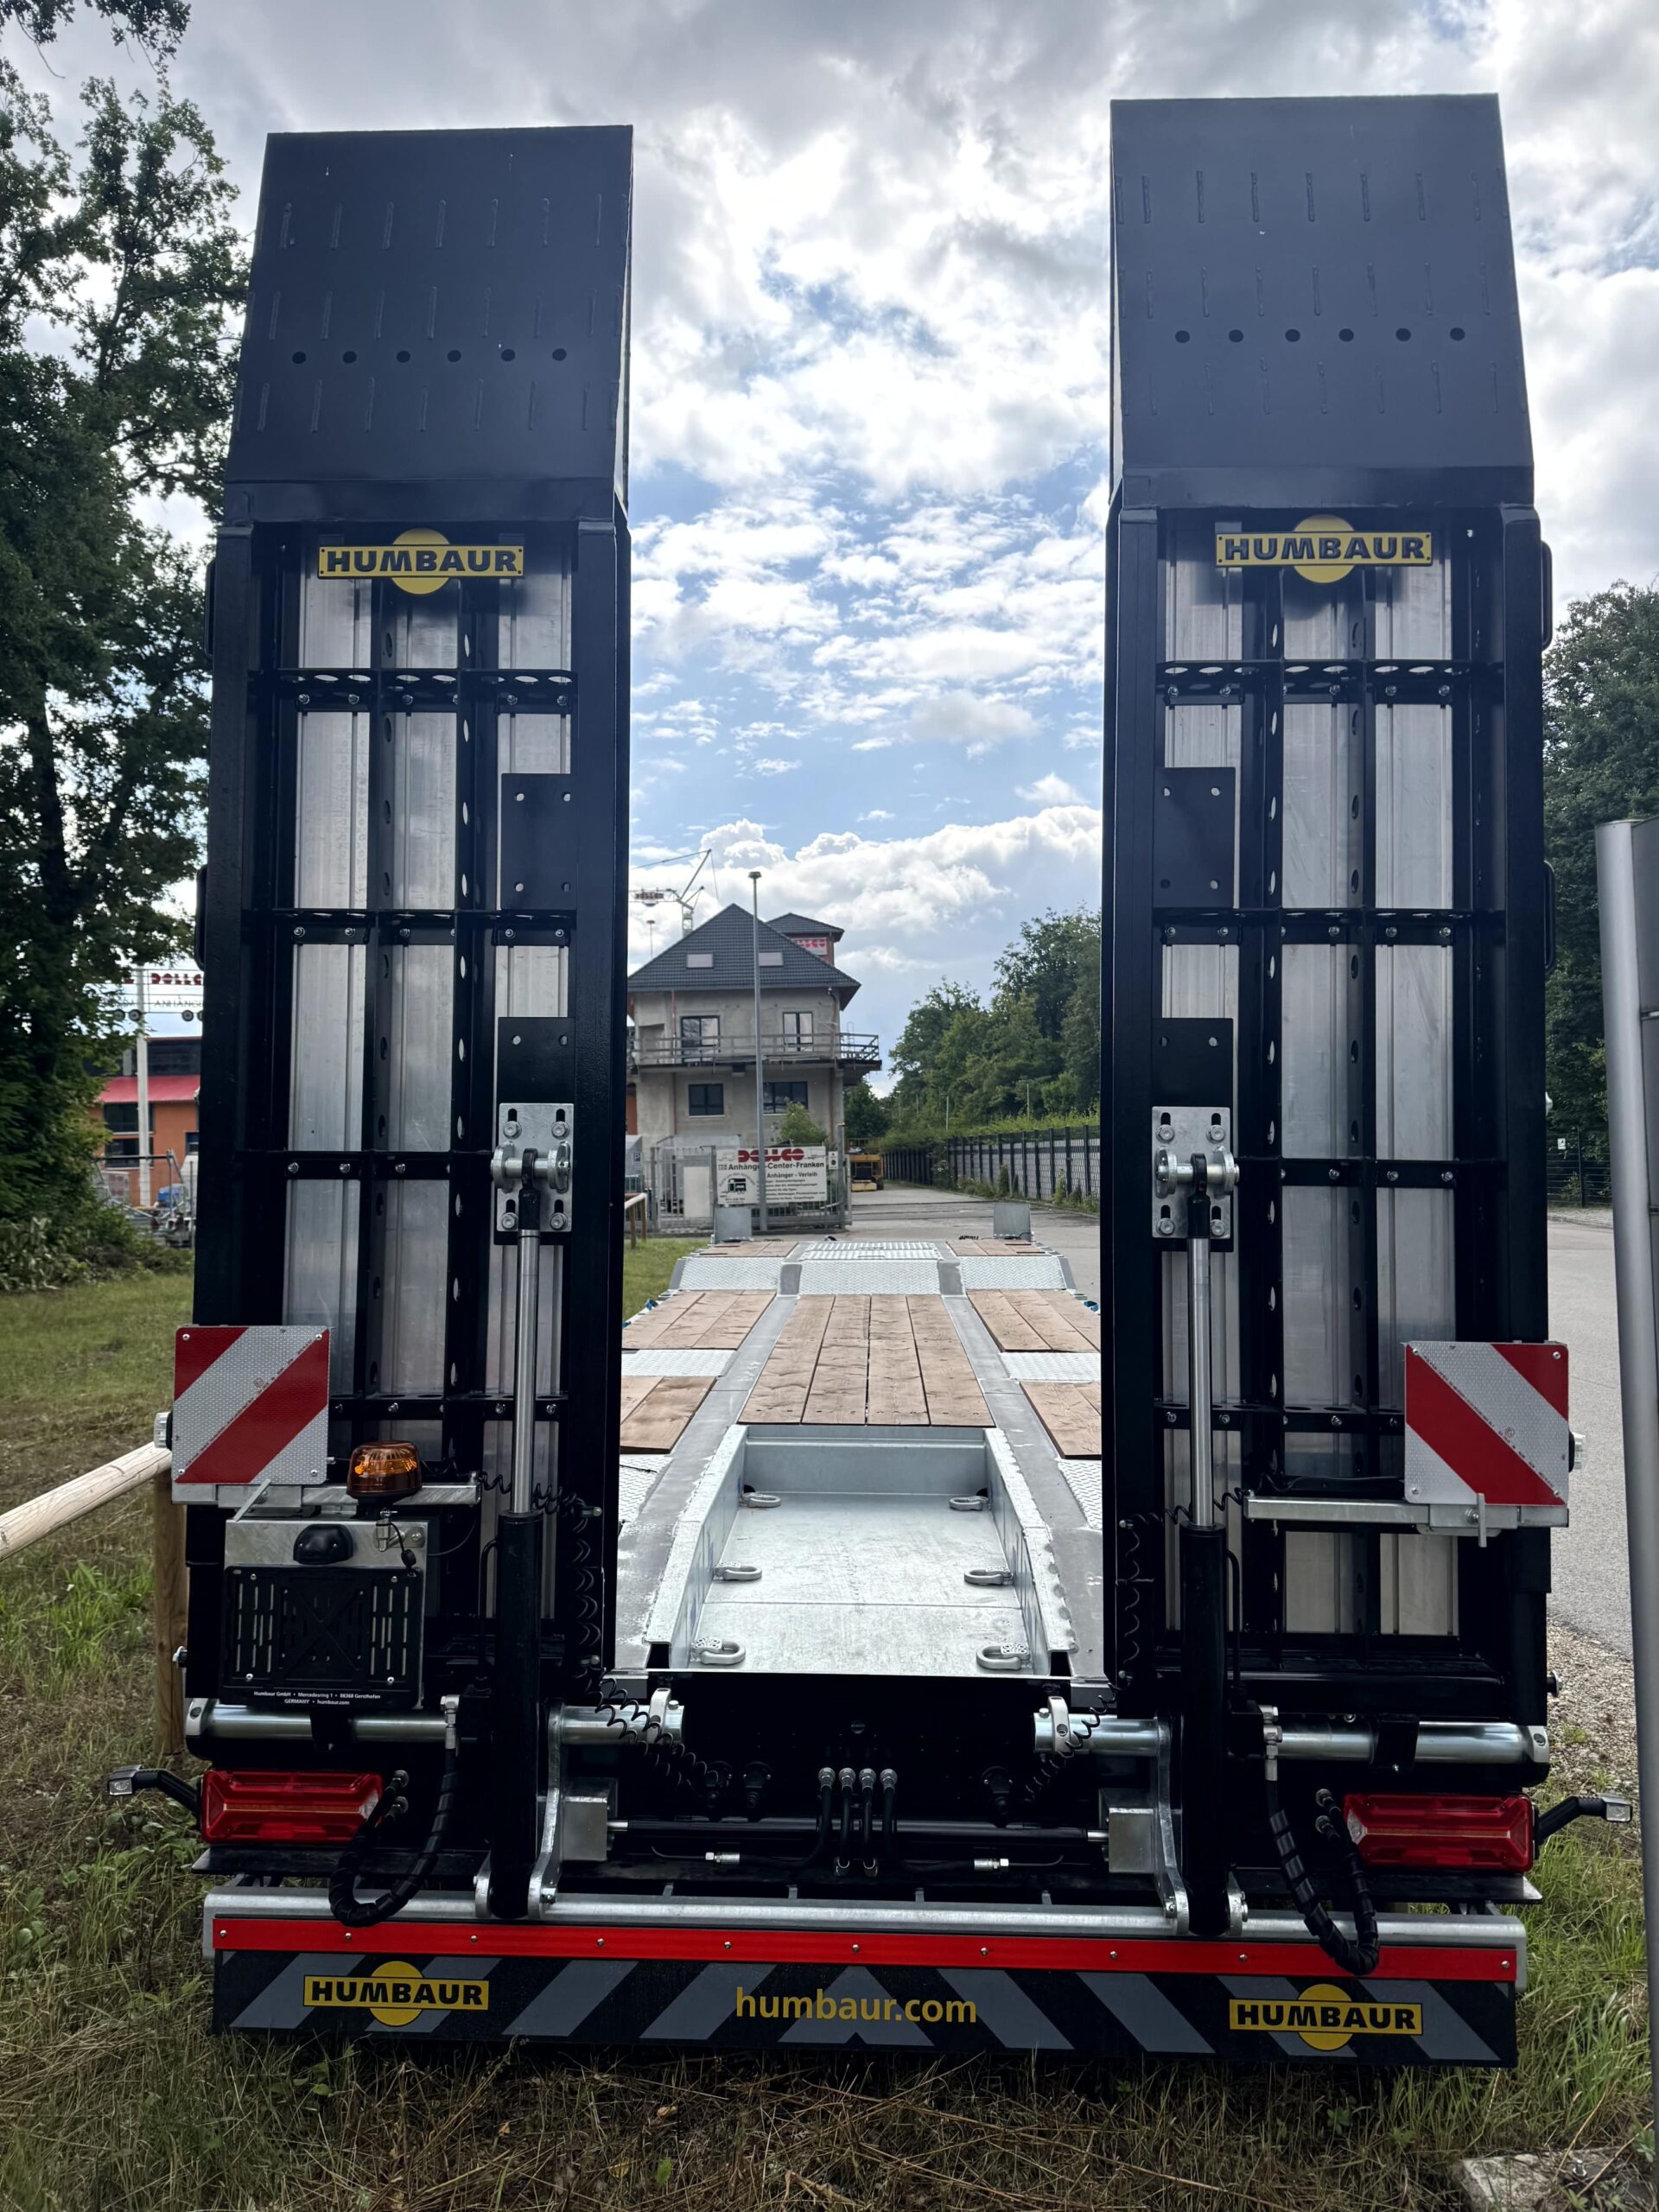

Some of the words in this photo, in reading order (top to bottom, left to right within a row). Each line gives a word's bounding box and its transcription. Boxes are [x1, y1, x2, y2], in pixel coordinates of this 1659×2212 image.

[1216, 537, 1425, 561] HUMBAUR
[326, 550, 518, 573] HUMBAUR
[151, 973, 201, 985] DOLLC
[312, 1980, 482, 2005] HUMBAUR
[736, 1986, 976, 2023] humbaur.com
[1237, 2005, 1415, 2029] HUMBAUR
